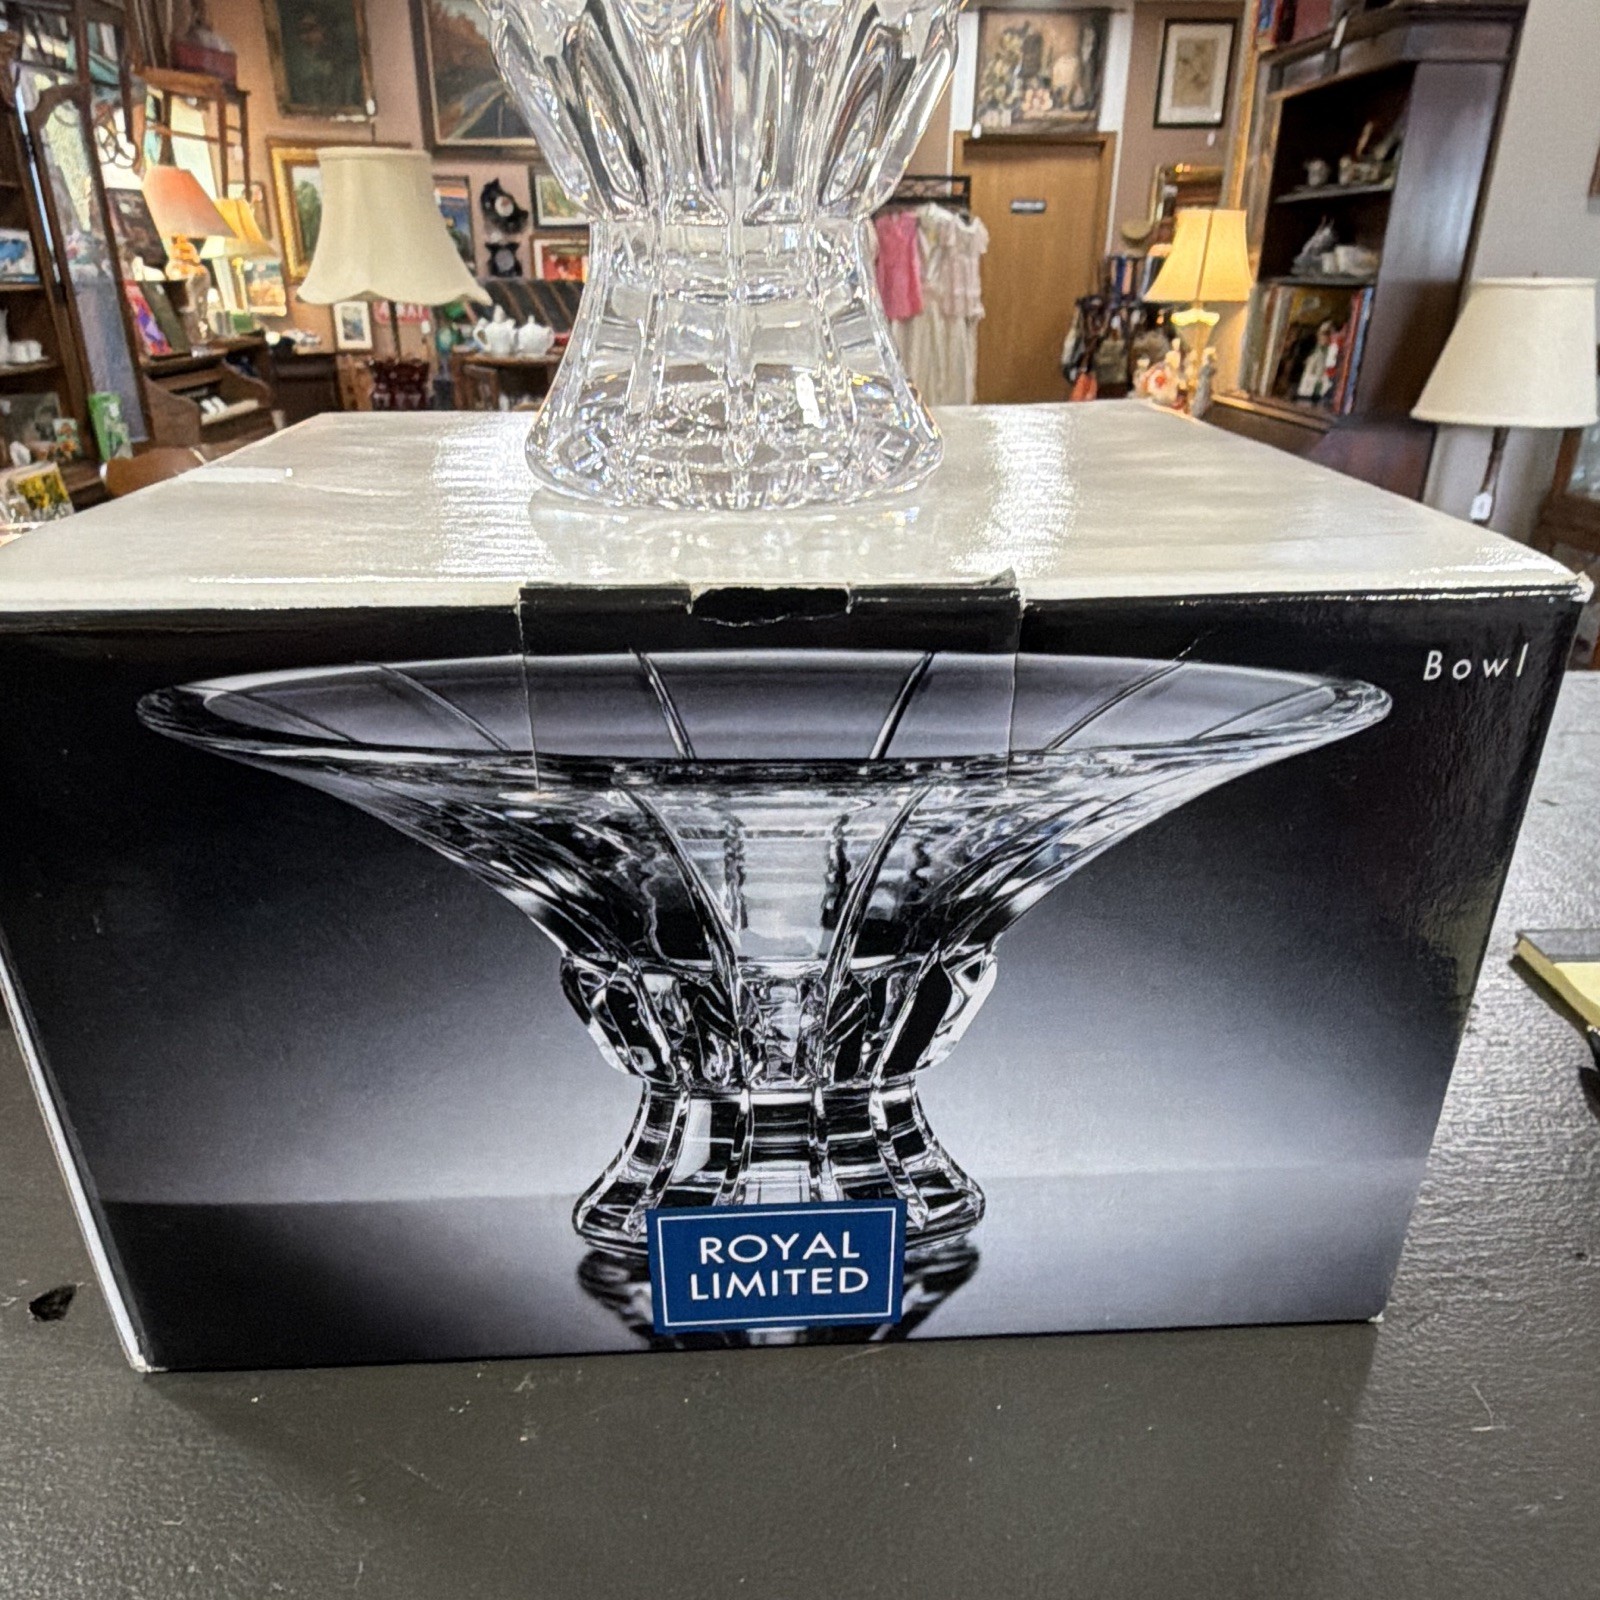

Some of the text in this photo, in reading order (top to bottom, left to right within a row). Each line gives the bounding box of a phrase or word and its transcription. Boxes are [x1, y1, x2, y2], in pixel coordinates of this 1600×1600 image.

[1423, 642, 1529, 680] Bowl
[700, 1231, 860, 1265] ROYAL
[690, 1267, 869, 1300] LIMITED
